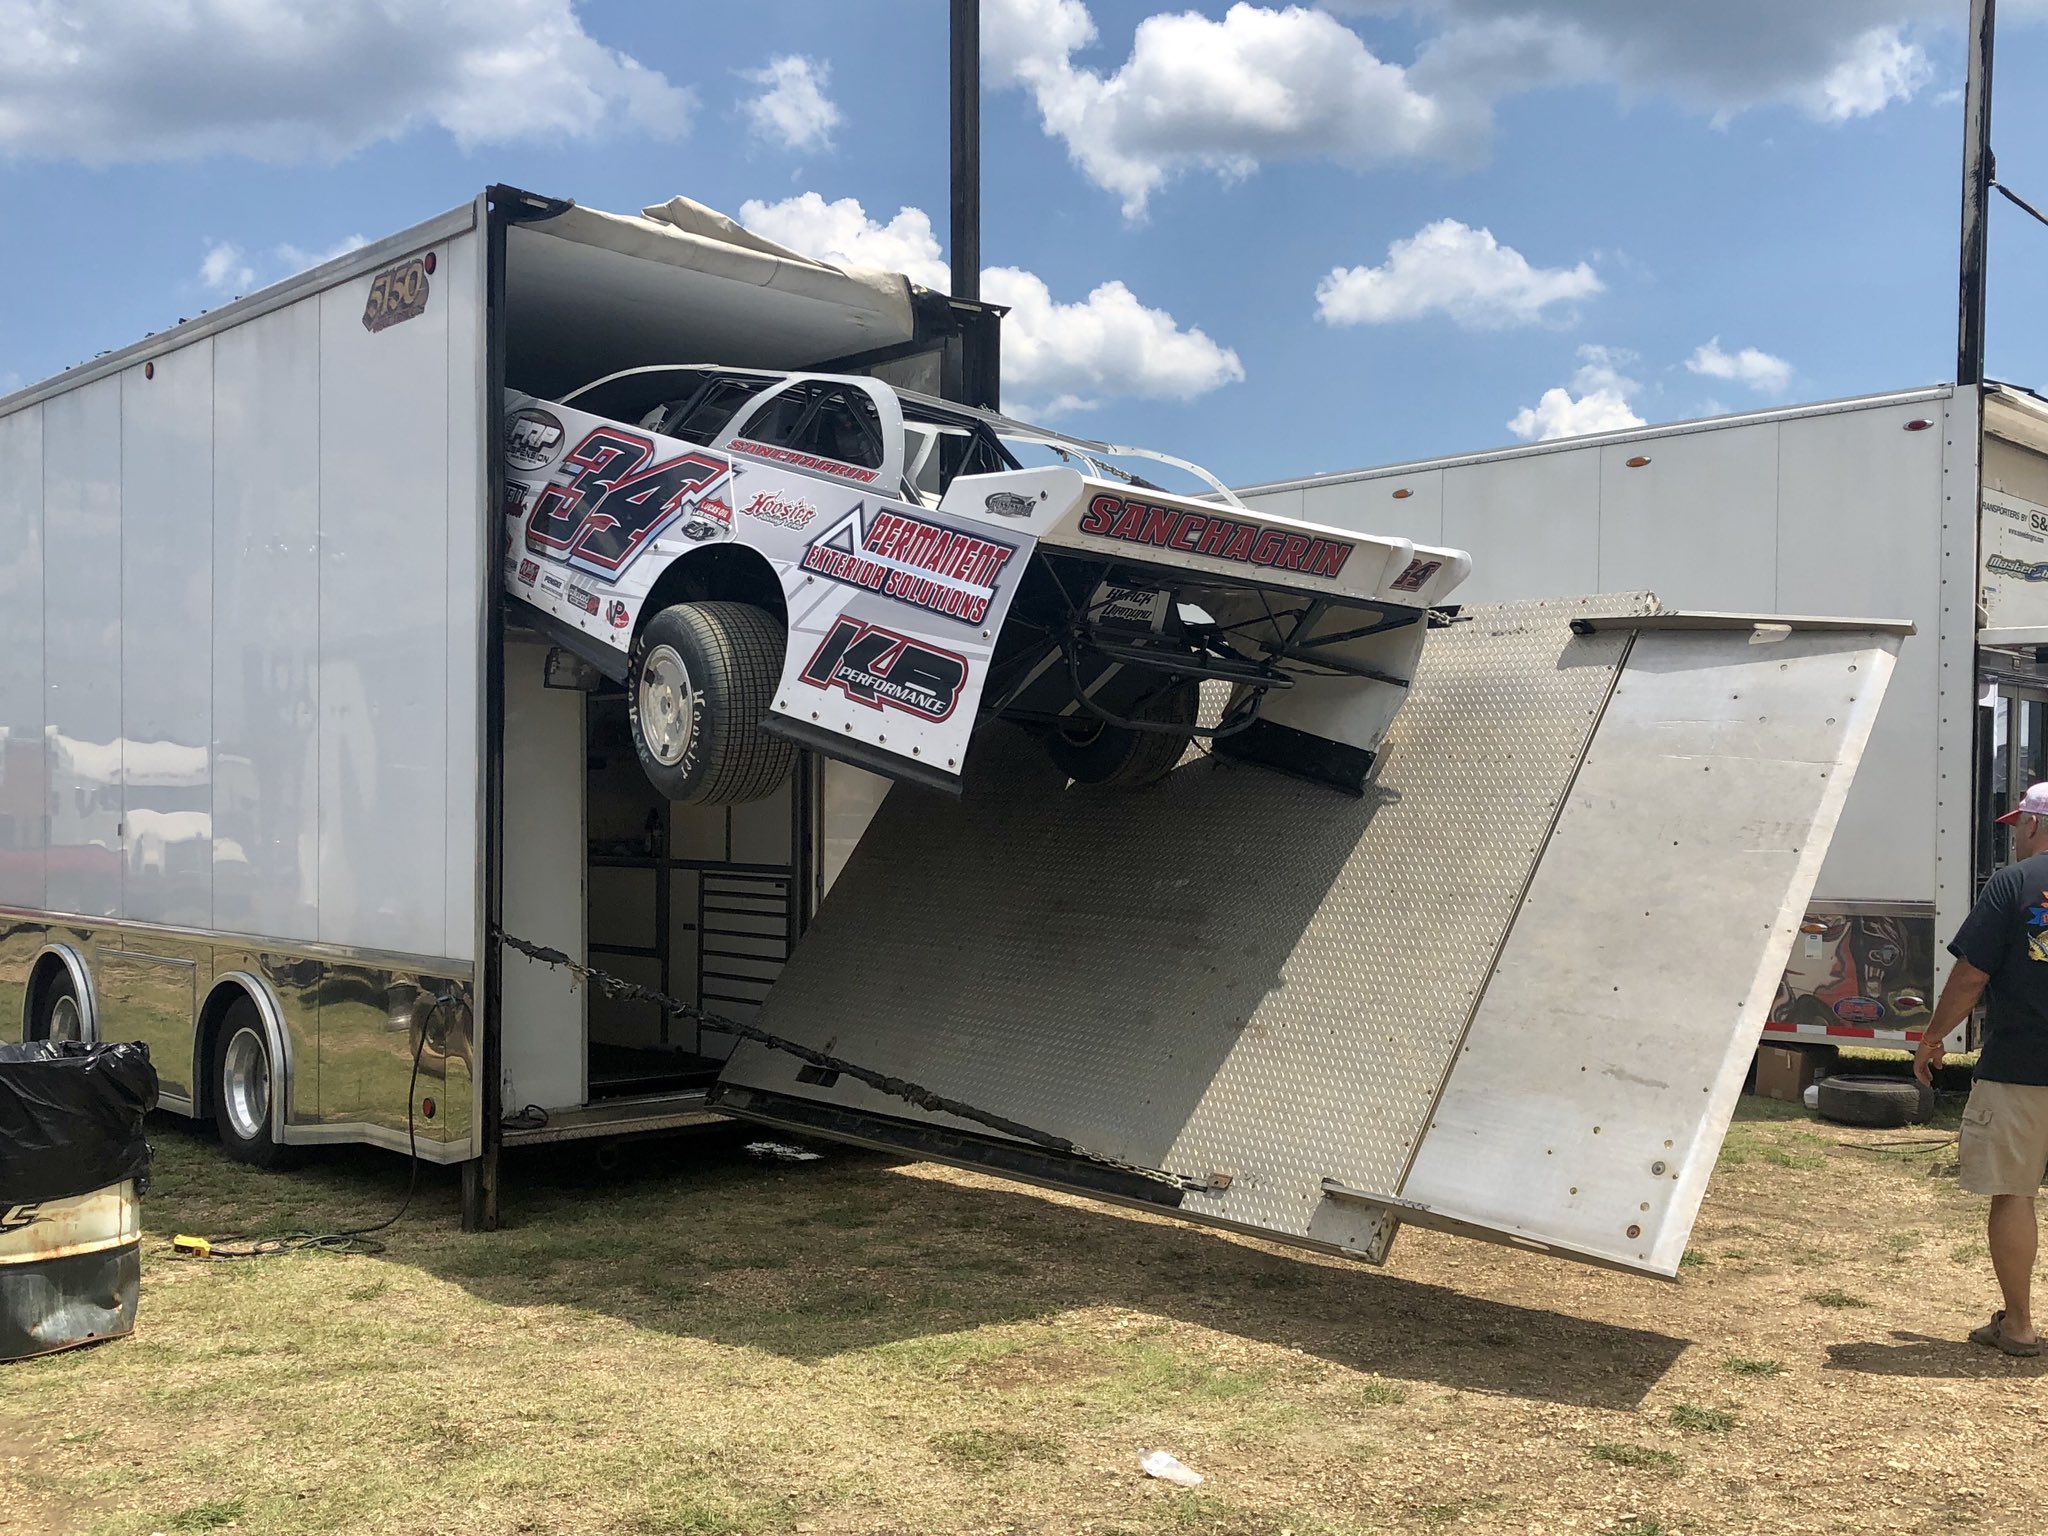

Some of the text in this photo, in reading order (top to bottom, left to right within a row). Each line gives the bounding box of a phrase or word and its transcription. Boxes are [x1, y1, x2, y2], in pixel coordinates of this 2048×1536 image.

[368, 263, 423, 317] 5150
[505, 446, 549, 463] USPENSION
[727, 439, 881, 483] SANCHAGRIN
[527, 426, 740, 578] 34
[700, 501, 729, 518] LUCAS OIL
[1982, 501, 2020, 521] RANSPORTERS
[2021, 513, 2028, 522] BY
[863, 512, 1013, 589] PERMANENT
[1081, 496, 1353, 577] SANCHAGRIN
[804, 546, 988, 623] EXTERIOR SOLUTIONS
[838, 667, 947, 713] PERFORMANCE
